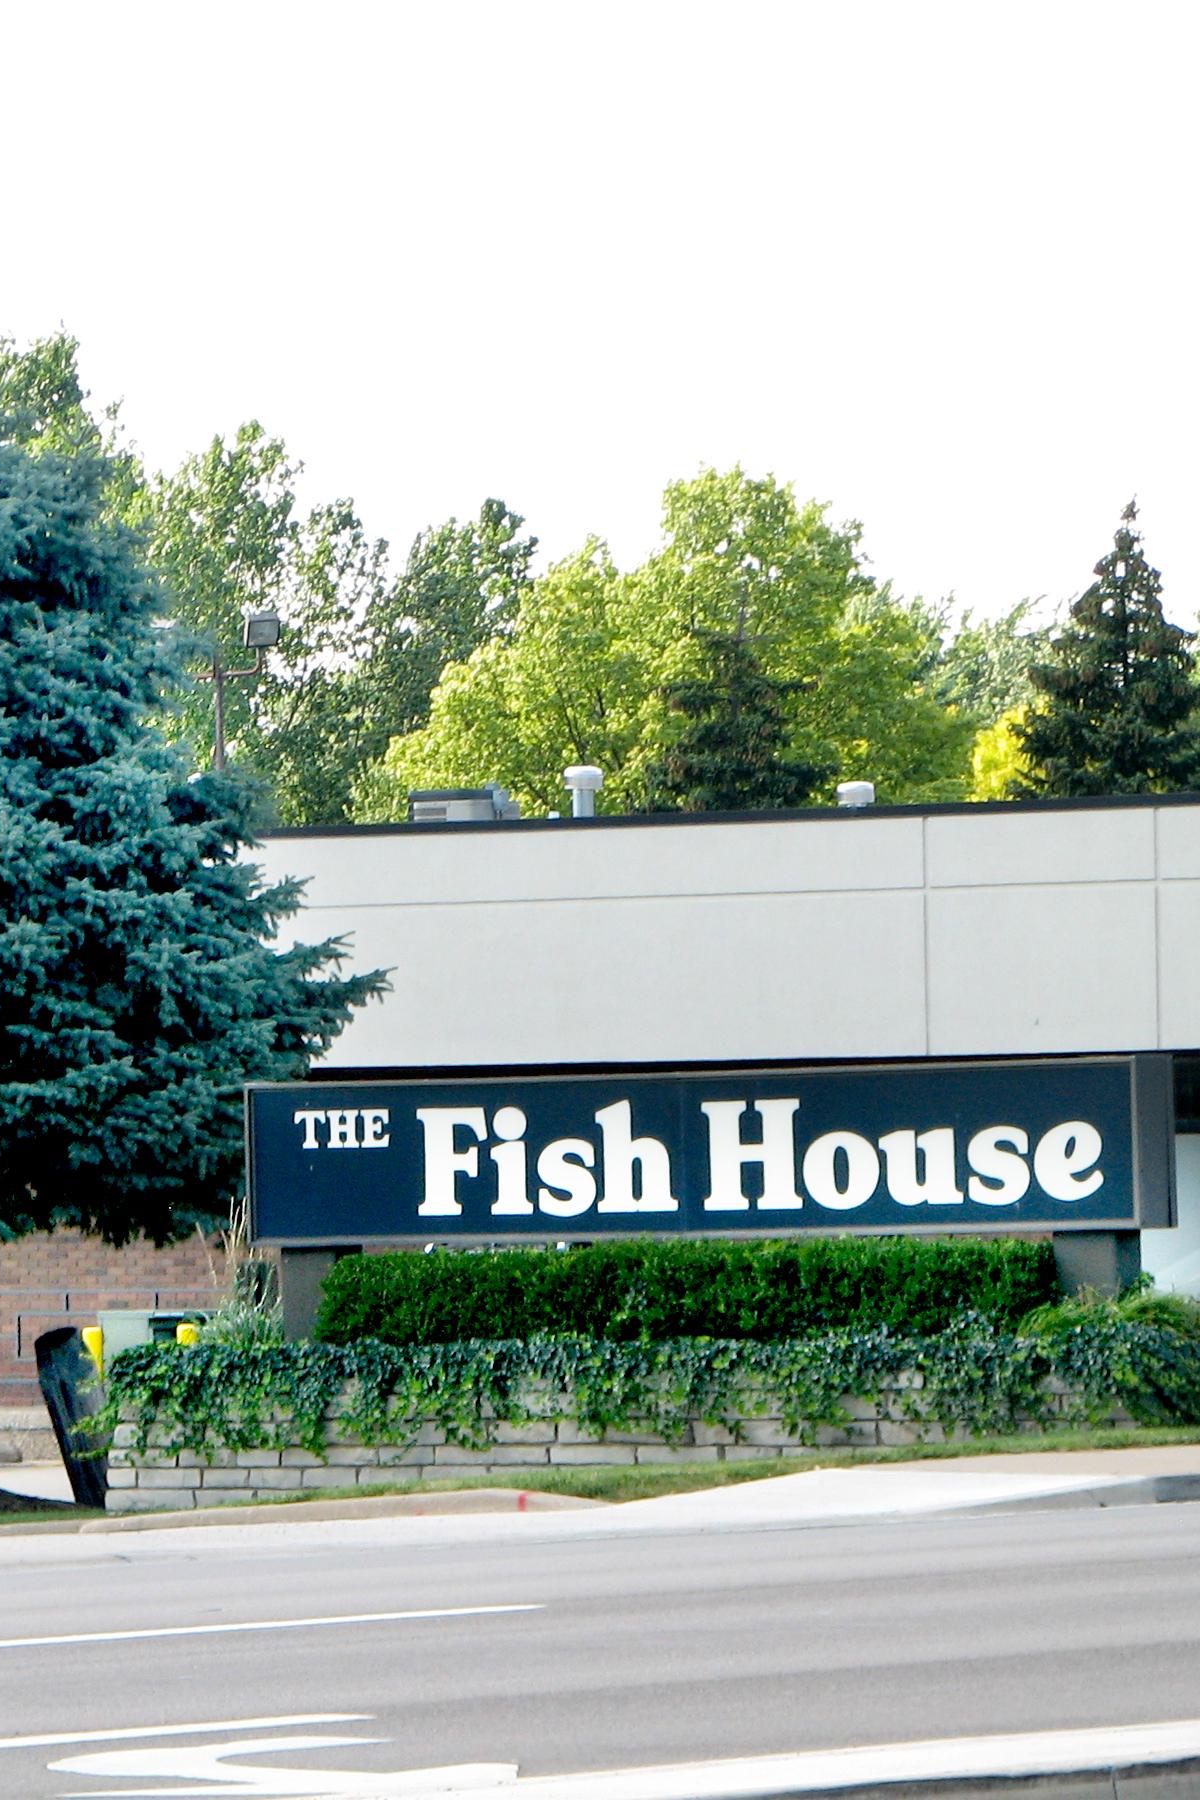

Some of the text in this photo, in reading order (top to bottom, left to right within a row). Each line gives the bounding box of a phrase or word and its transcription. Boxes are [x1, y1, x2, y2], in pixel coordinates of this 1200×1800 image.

[293, 1098, 1104, 1218] THE Fish House
